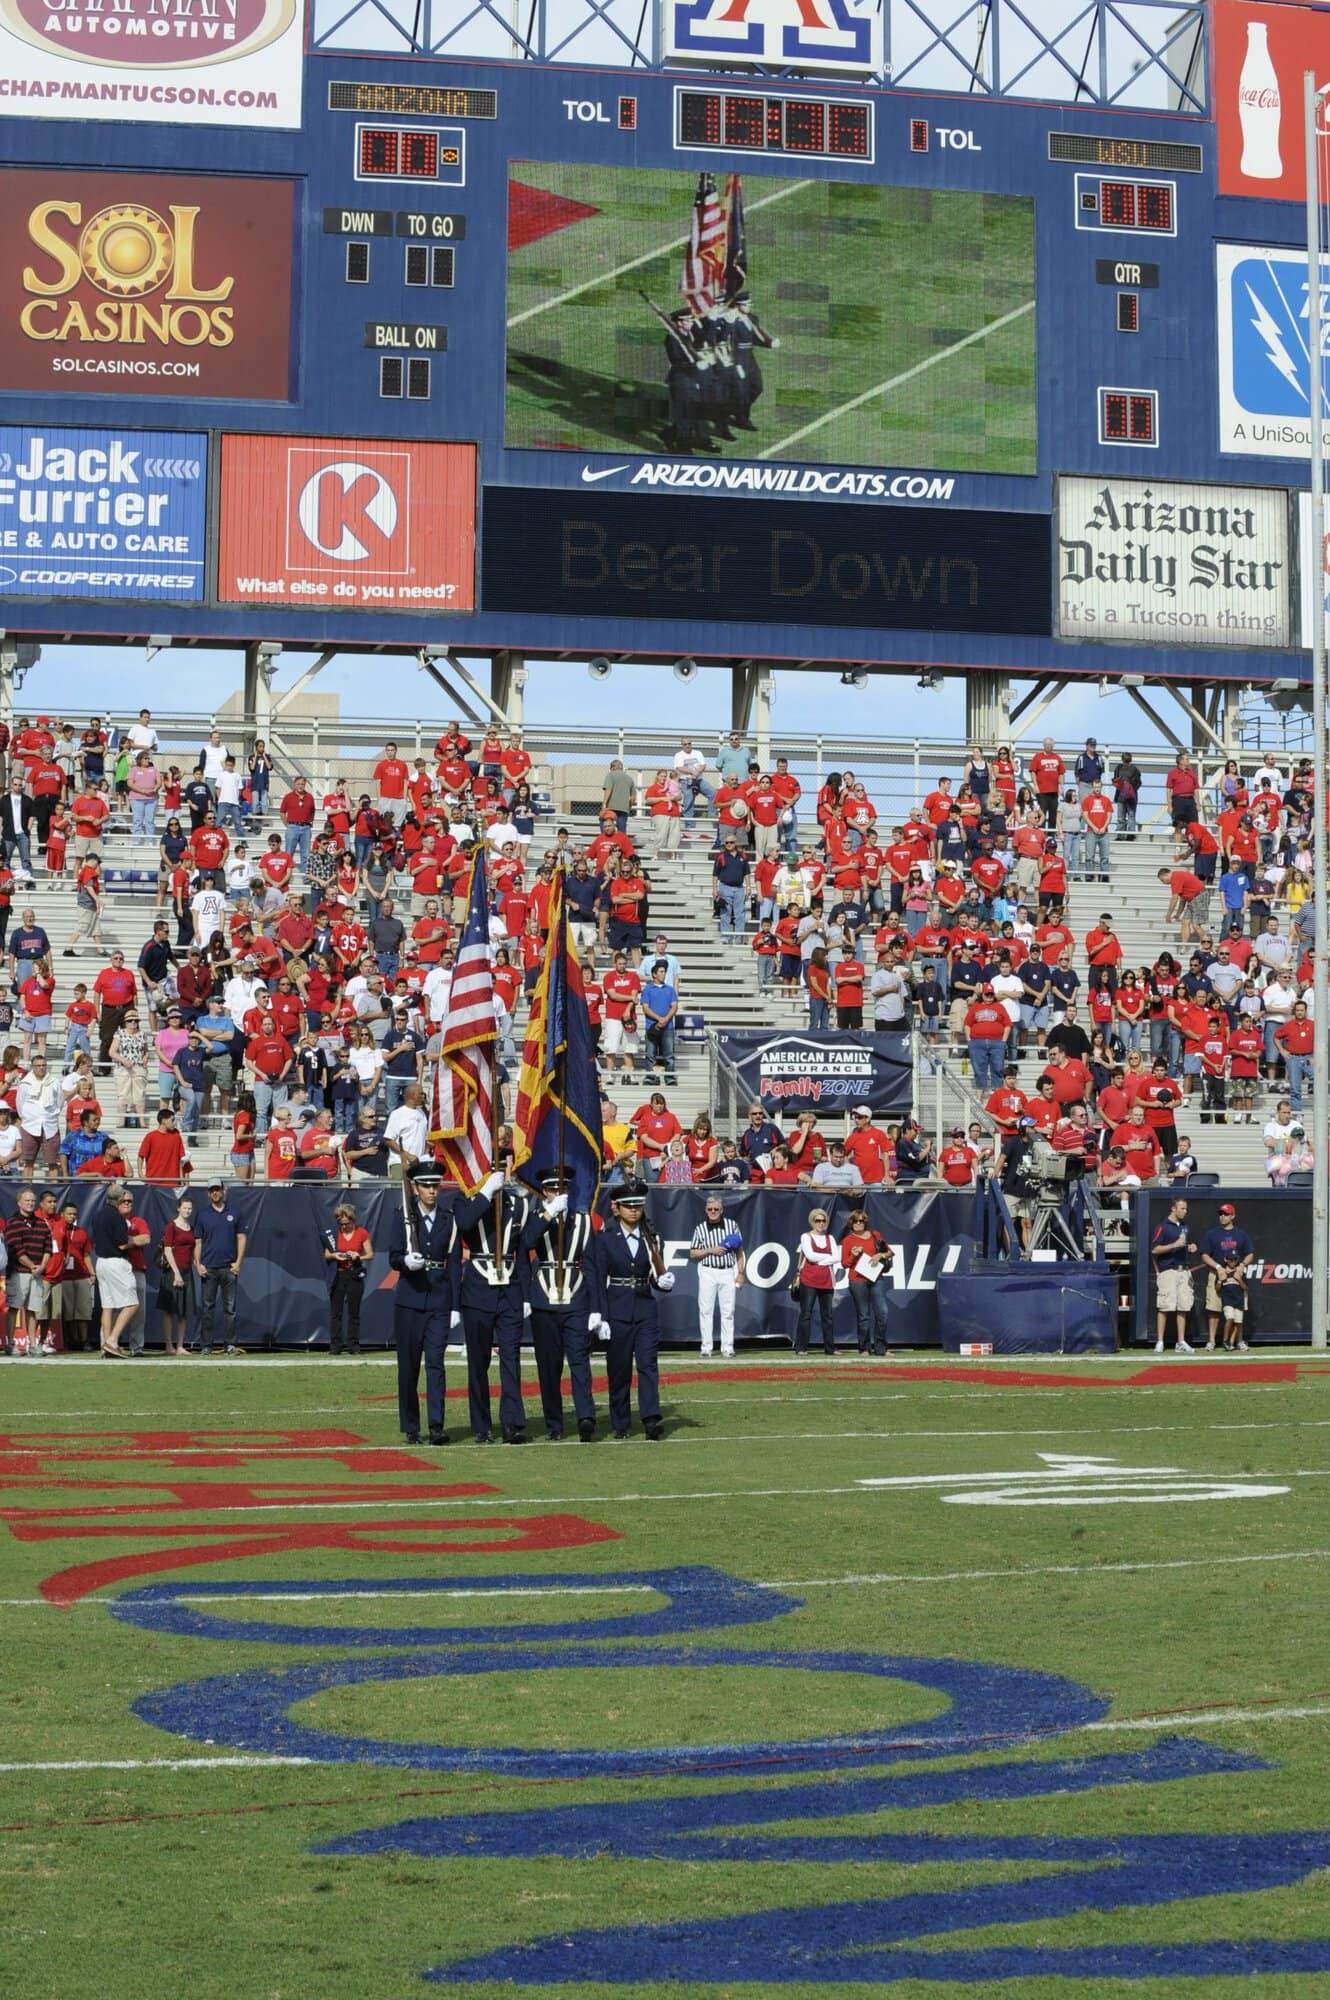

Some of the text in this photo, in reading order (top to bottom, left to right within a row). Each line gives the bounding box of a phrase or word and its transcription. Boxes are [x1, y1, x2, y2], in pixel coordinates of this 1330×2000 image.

[44, 15, 236, 40] AUTOMOTIVE
[0, 79, 278, 109] CHAPMANTUCSON.COM
[357, 85, 468, 118] ARIZONA
[562, 99, 611, 123] TOL
[935, 128, 982, 152] TOL
[362, 131, 438, 176] 00
[1098, 140, 1147, 166] WSU
[1101, 184, 1170, 227] 00
[341, 211, 375, 233] DWN
[408, 214, 453, 237] TO GO
[23, 200, 235, 301] SOL
[1114, 262, 1141, 285] QTR
[20, 299, 234, 347] CASINOS
[375, 325, 436, 348] BALL ON
[52, 358, 200, 376] SOLCASINOS.COM
[1233, 423, 1247, 440] A
[16, 438, 140, 484] Jack
[630, 463, 956, 500] ARIZONAWILDCATS.COM
[318, 471, 380, 551] K
[1085, 486, 1258, 539] Arizona
[25, 531, 43, 548] &
[51, 532, 118, 550] AUTO
[125, 535, 189, 553] CARE
[560, 519, 981, 606] Bear Down
[1059, 535, 1177, 598] Daily
[1189, 544, 1284, 592] Star
[236, 577, 456, 600] What else do you need?
[1062, 601, 1096, 623] It's
[1105, 609, 1119, 624] a
[1126, 603, 1209, 628] Tucson
[340, 935, 358, 951] 35
[760, 1052, 871, 1063] AMERICAN FAMILY
[769, 1065, 864, 1074] INSURANCE
